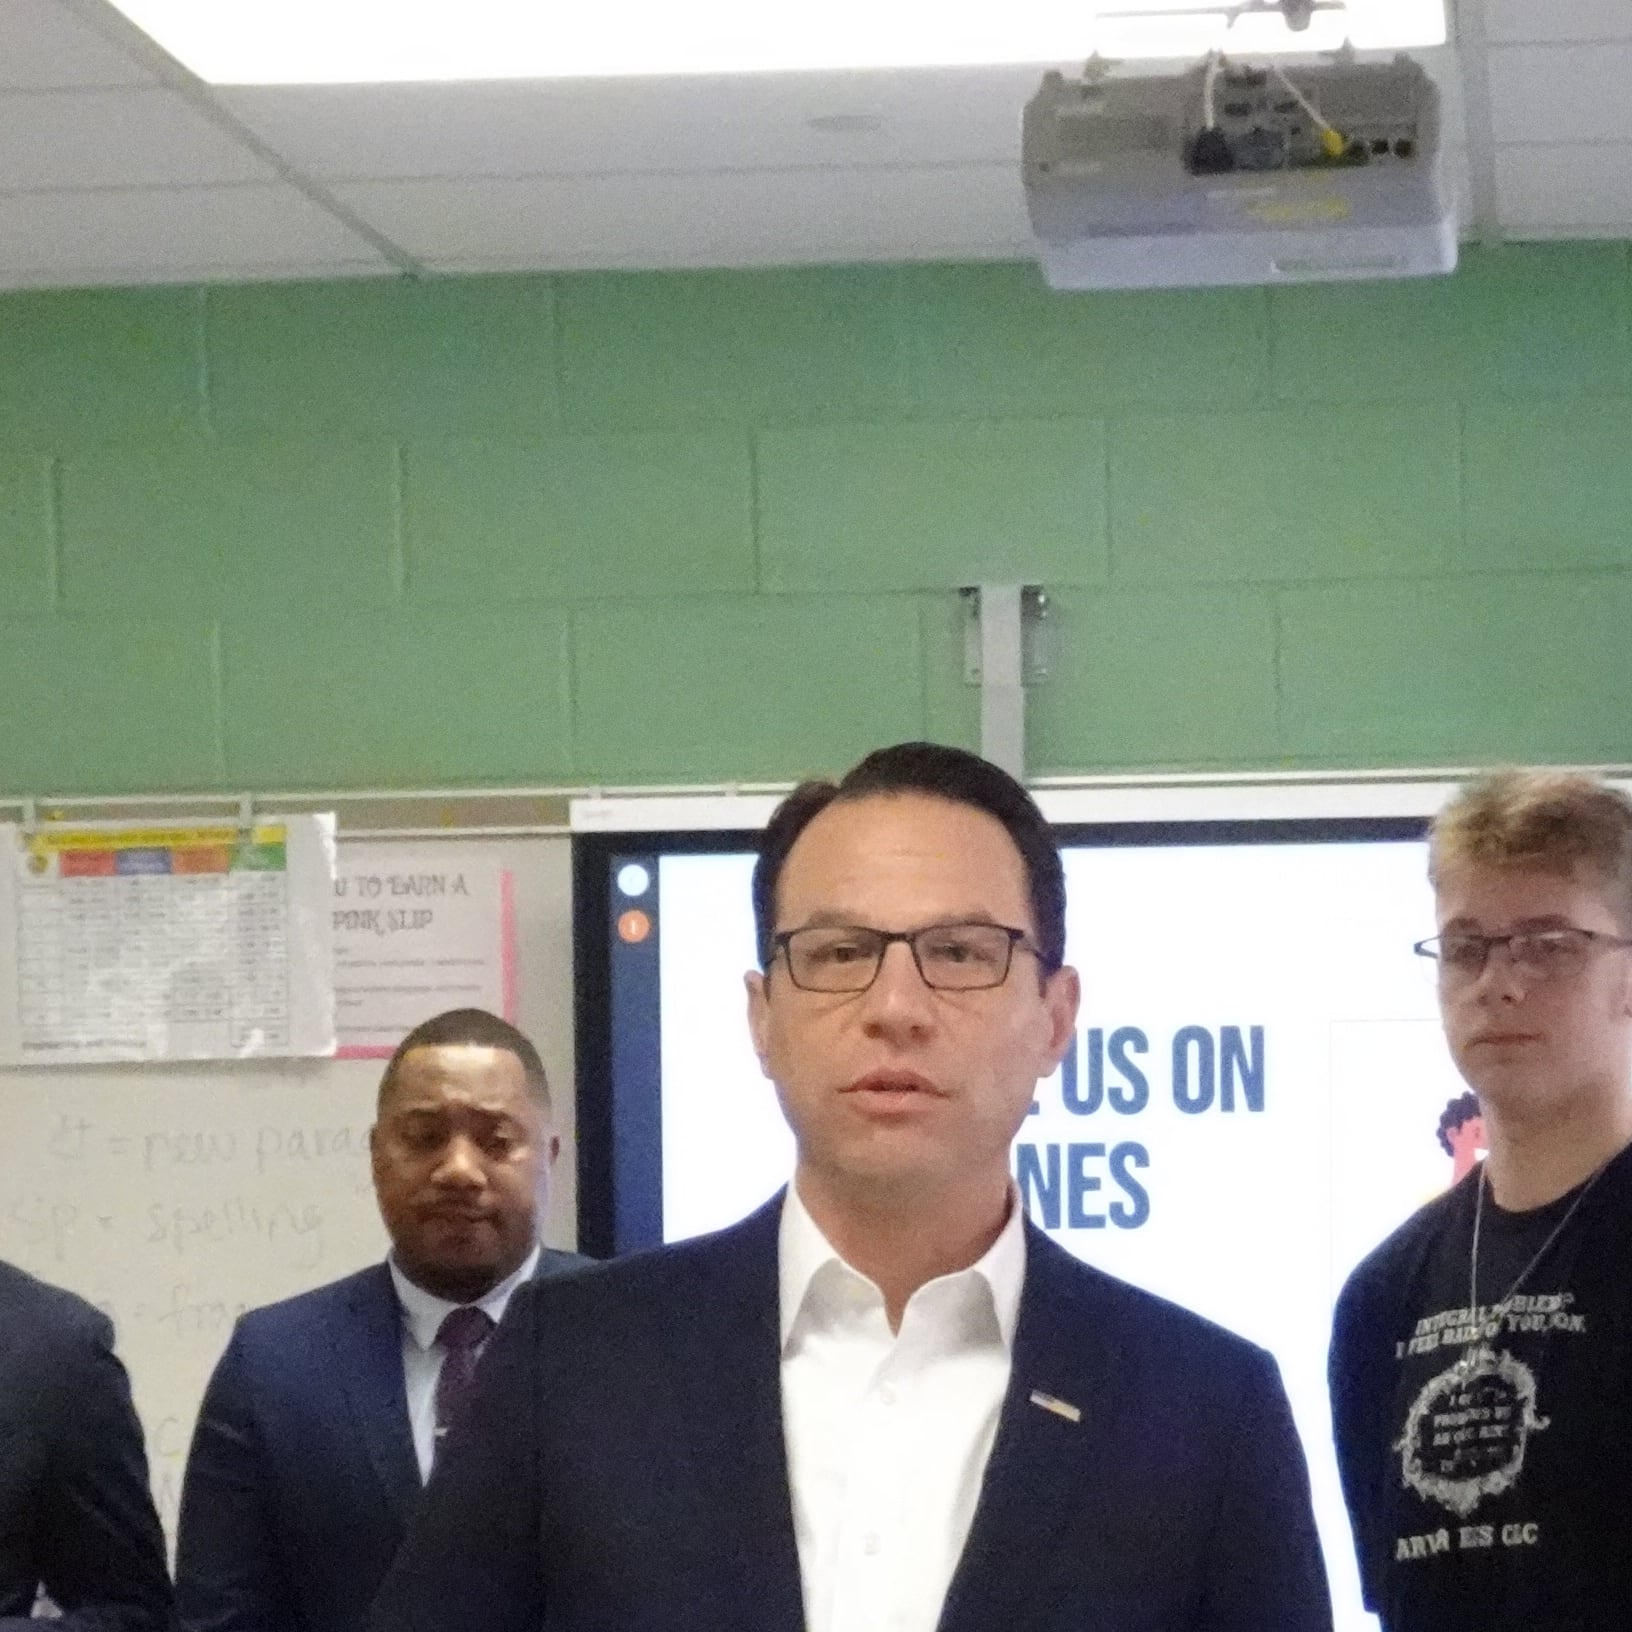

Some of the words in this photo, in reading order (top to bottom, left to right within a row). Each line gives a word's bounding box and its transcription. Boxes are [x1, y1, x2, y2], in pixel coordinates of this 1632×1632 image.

[356, 875, 382, 897] TO
[451, 873, 469, 896] A
[388, 910, 434, 933] SLIP
[1062, 1025, 1151, 1117] US
[1171, 1024, 1265, 1116] ON
[1015, 1141, 1151, 1230] NES
